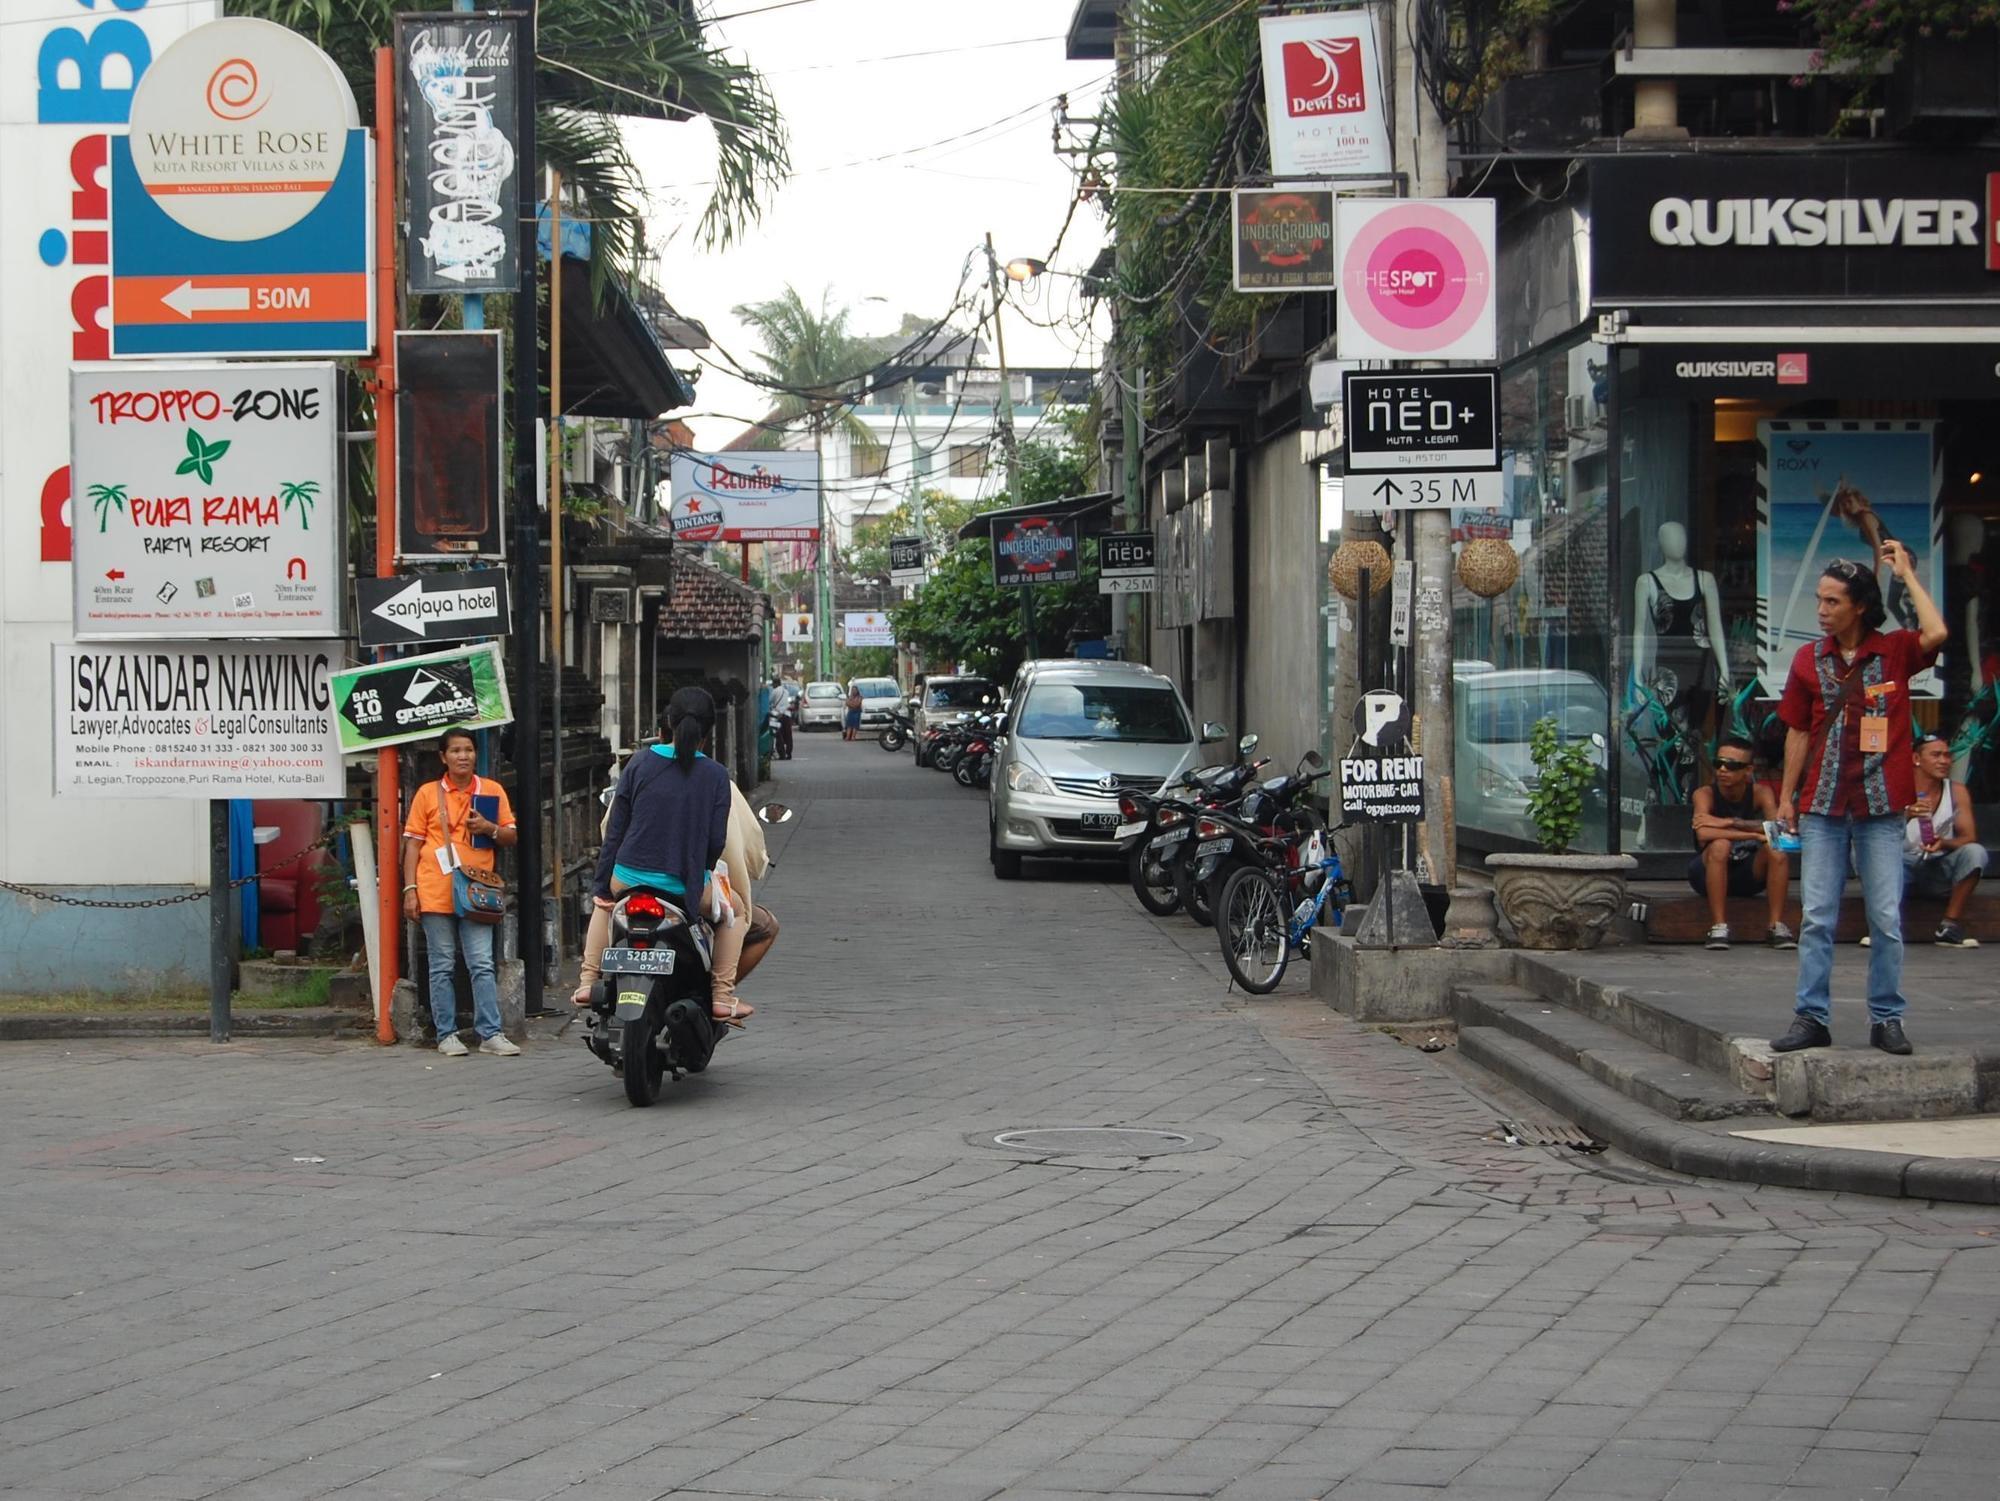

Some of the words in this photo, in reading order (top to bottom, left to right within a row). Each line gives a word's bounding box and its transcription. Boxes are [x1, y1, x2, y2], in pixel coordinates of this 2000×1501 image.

[475, 29, 511, 57] Ink
[1293, 95, 1333, 113] Dewi
[1336, 92, 1361, 109] Sri
[1297, 124, 1360, 139] HOTEL
[148, 132, 244, 156] WHITE
[258, 131, 328, 154] ROSE
[1336, 136, 1355, 147] 100
[153, 160, 186, 173] KUTA
[191, 160, 238, 172] RESORT
[242, 158, 285, 172] VILLAS
[288, 159, 299, 170] &
[303, 158, 326, 171] SPA
[1650, 197, 1979, 247] QUIKSILVER
[466, 268, 478, 277] 10
[479, 268, 489, 277] M
[256, 288, 311, 310] 50M
[1676, 360, 1776, 379] QUIKSILVER
[1368, 387, 1432, 399] HOTEL
[90, 387, 320, 425] TROPPO-ZONE
[1386, 436, 1412, 445] KUTA
[1425, 435, 1458, 444] LEGIAN
[1399, 455, 1411, 464] by
[1776, 457, 1820, 472] ROXY
[1409, 480, 1442, 503] 35
[1452, 478, 1476, 502] M
[130, 497, 192, 527] PURI
[203, 495, 279, 527] RAMA
[673, 513, 720, 531] BINTANG
[144, 536, 192, 557] PARTY
[201, 536, 271, 552] RESORT
[1125, 579, 1139, 591] 25
[1141, 578, 1153, 590] M
[387, 597, 453, 619] sanjaya
[458, 590, 496, 612] hotel
[70, 654, 210, 712] ISKANDAR
[217, 654, 330, 712] NAWING
[352, 689, 379, 701] BAR
[354, 700, 382, 718] 10
[194, 717, 209, 736] &
[211, 715, 246, 740] Legal
[248, 713, 328, 735] Consultants
[1361, 694, 1403, 747] P
[76, 744, 110, 754] Mobile
[113, 744, 146, 754] Phone
[155, 743, 197, 753] 0815240
[200, 743, 212, 752] 31
[215, 743, 233, 752] 333
[242, 743, 266, 752] 0821
[269, 743, 287, 752] 300
[290, 743, 308, 752] 300
[311, 743, 324, 752] 33
[134, 755, 324, 770] iskandarnawing@yahoo.com
[1341, 759, 1378, 783] FOR
[1382, 757, 1423, 781] RENT
[212, 774, 243, 783] Rama
[1083, 813, 1096, 825] DK
